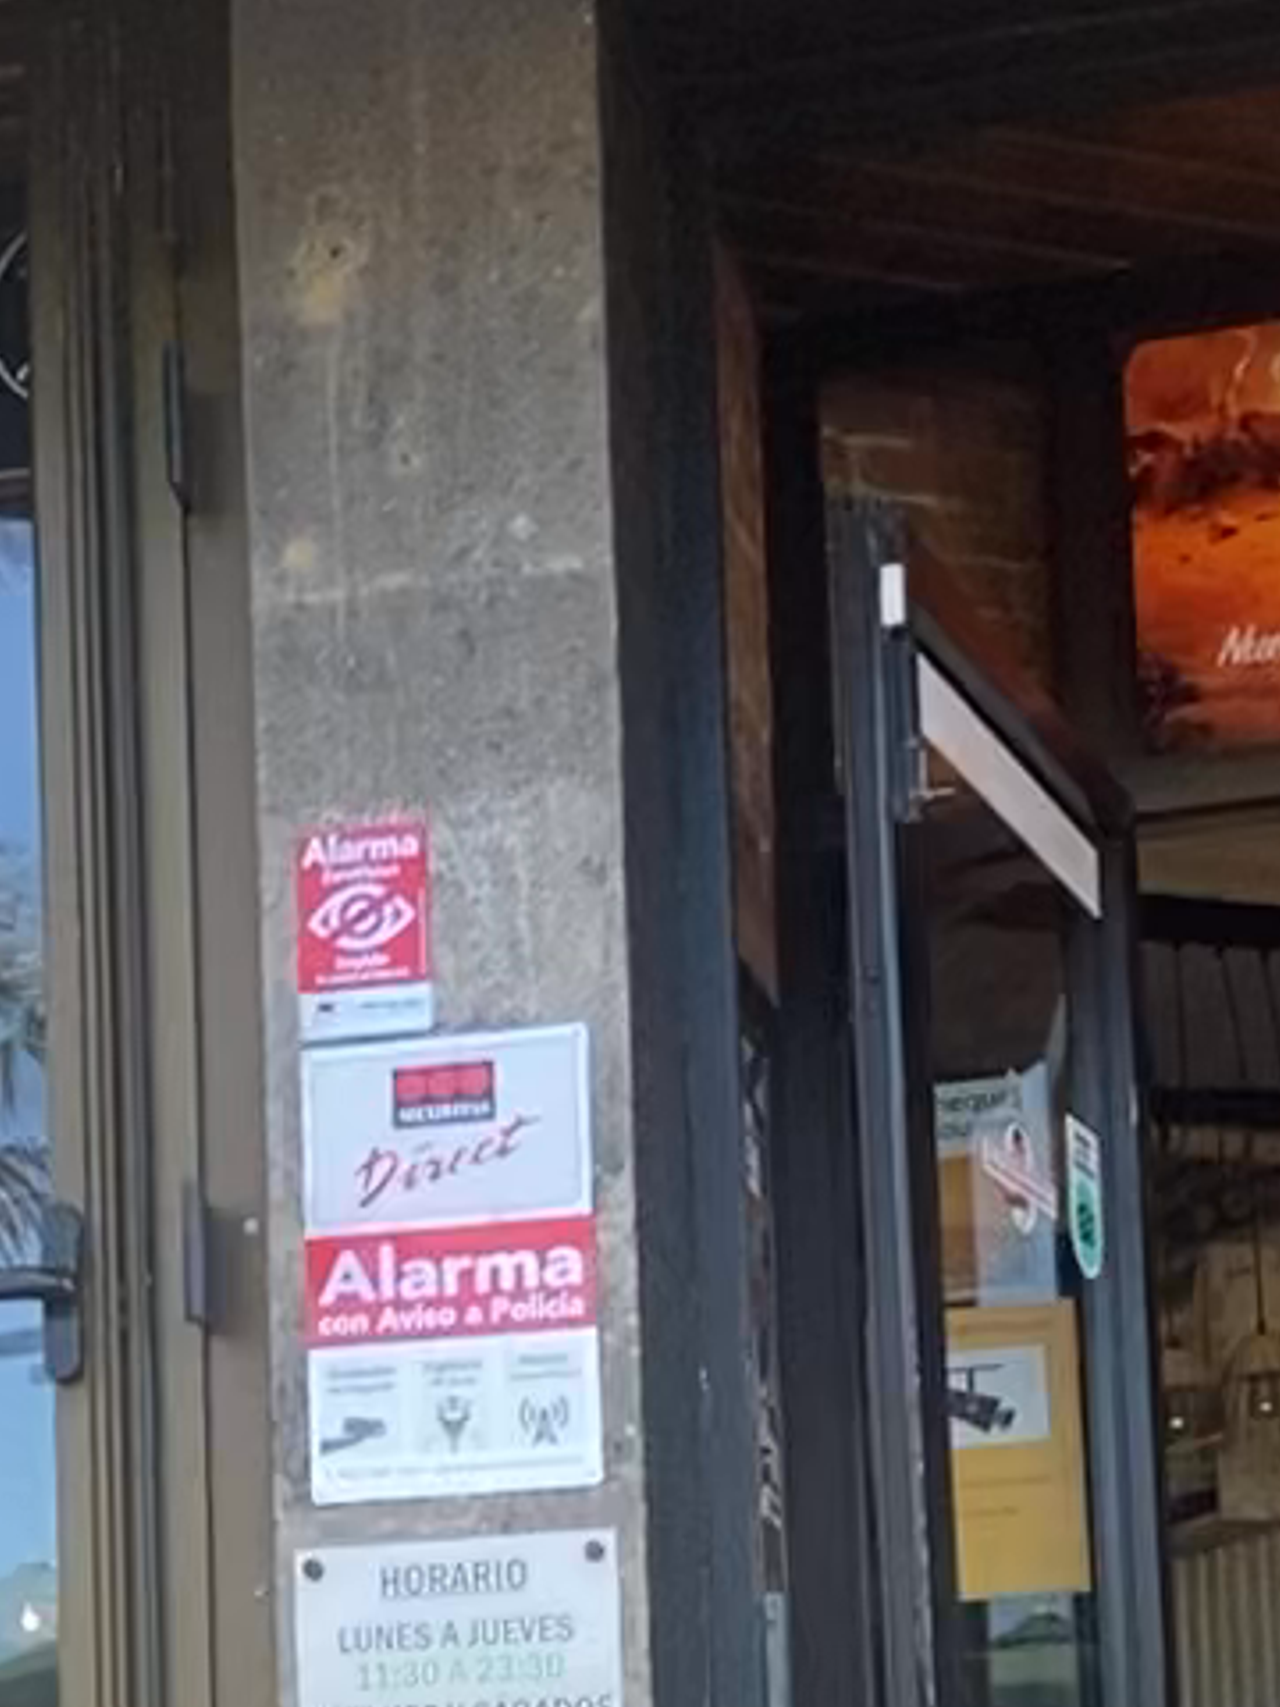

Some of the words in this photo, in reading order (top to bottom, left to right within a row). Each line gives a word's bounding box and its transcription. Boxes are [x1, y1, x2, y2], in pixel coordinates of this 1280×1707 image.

[302, 834, 419, 870] Alarma
[319, 1243, 584, 1307] Alarma
[318, 1311, 370, 1336] con
[377, 1304, 457, 1334] Aviso
[464, 1306, 484, 1326] a
[380, 1559, 528, 1598] HORARIO
[337, 1621, 432, 1654] LUNES
[440, 1620, 461, 1649] A
[467, 1614, 575, 1647] JUEVES
[358, 1660, 440, 1692] 11:30
[449, 1659, 471, 1685] A
